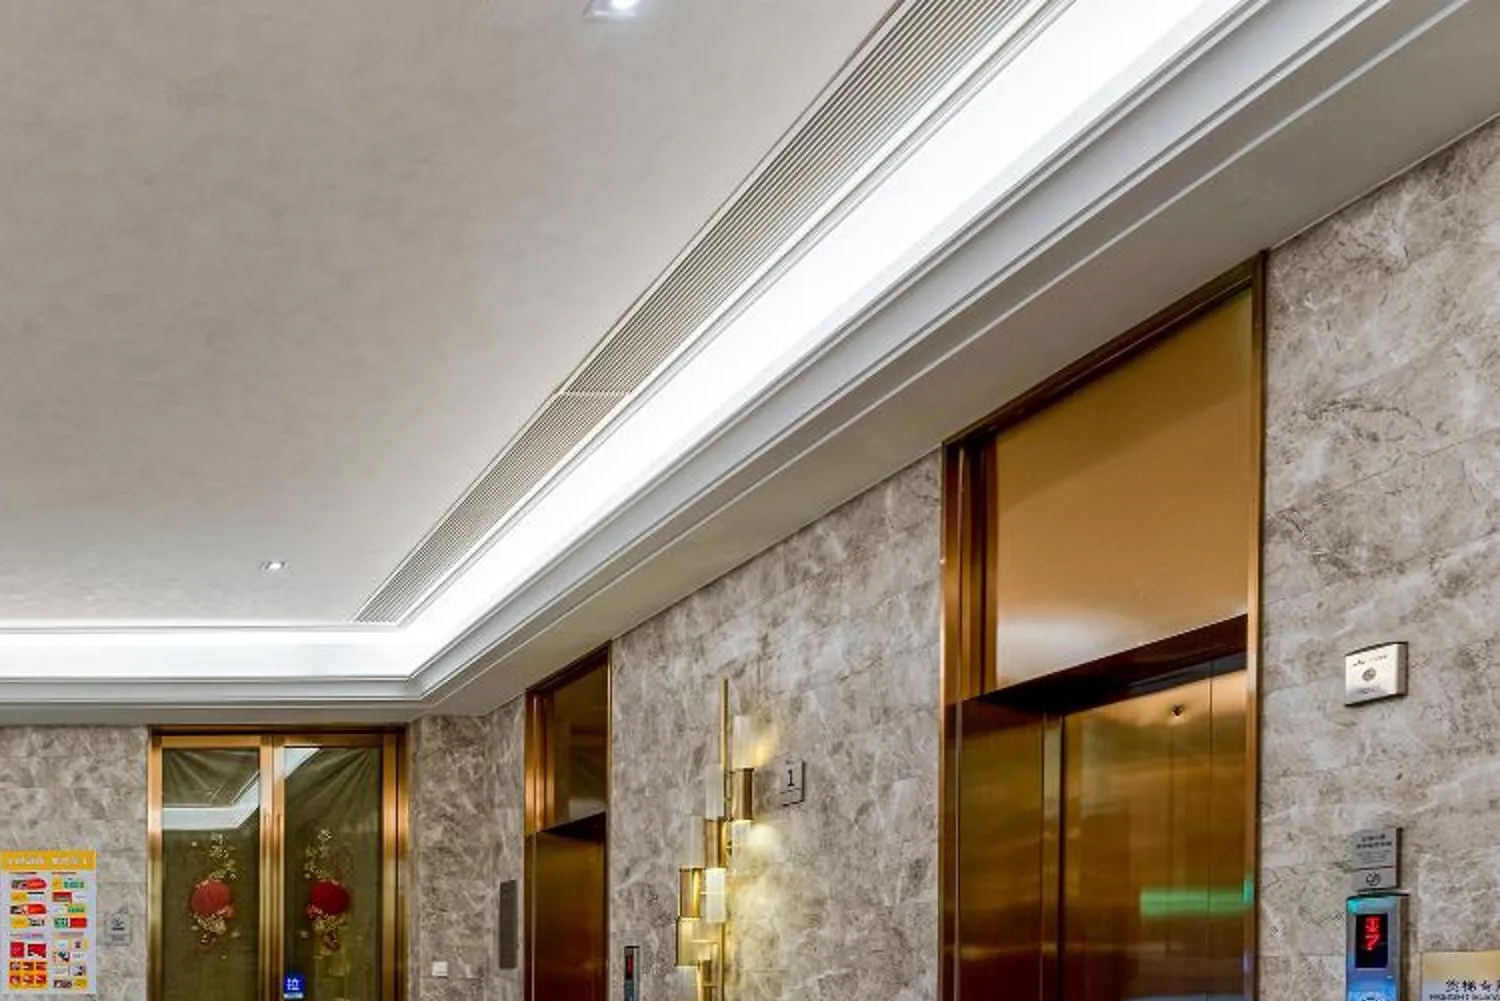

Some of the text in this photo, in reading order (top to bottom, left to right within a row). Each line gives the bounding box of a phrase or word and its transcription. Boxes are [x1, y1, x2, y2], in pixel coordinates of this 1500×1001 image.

[787, 768, 795, 787] 1
[286, 977, 301, 991] 拉
[1445, 979, 1500, 993] 货梯专
